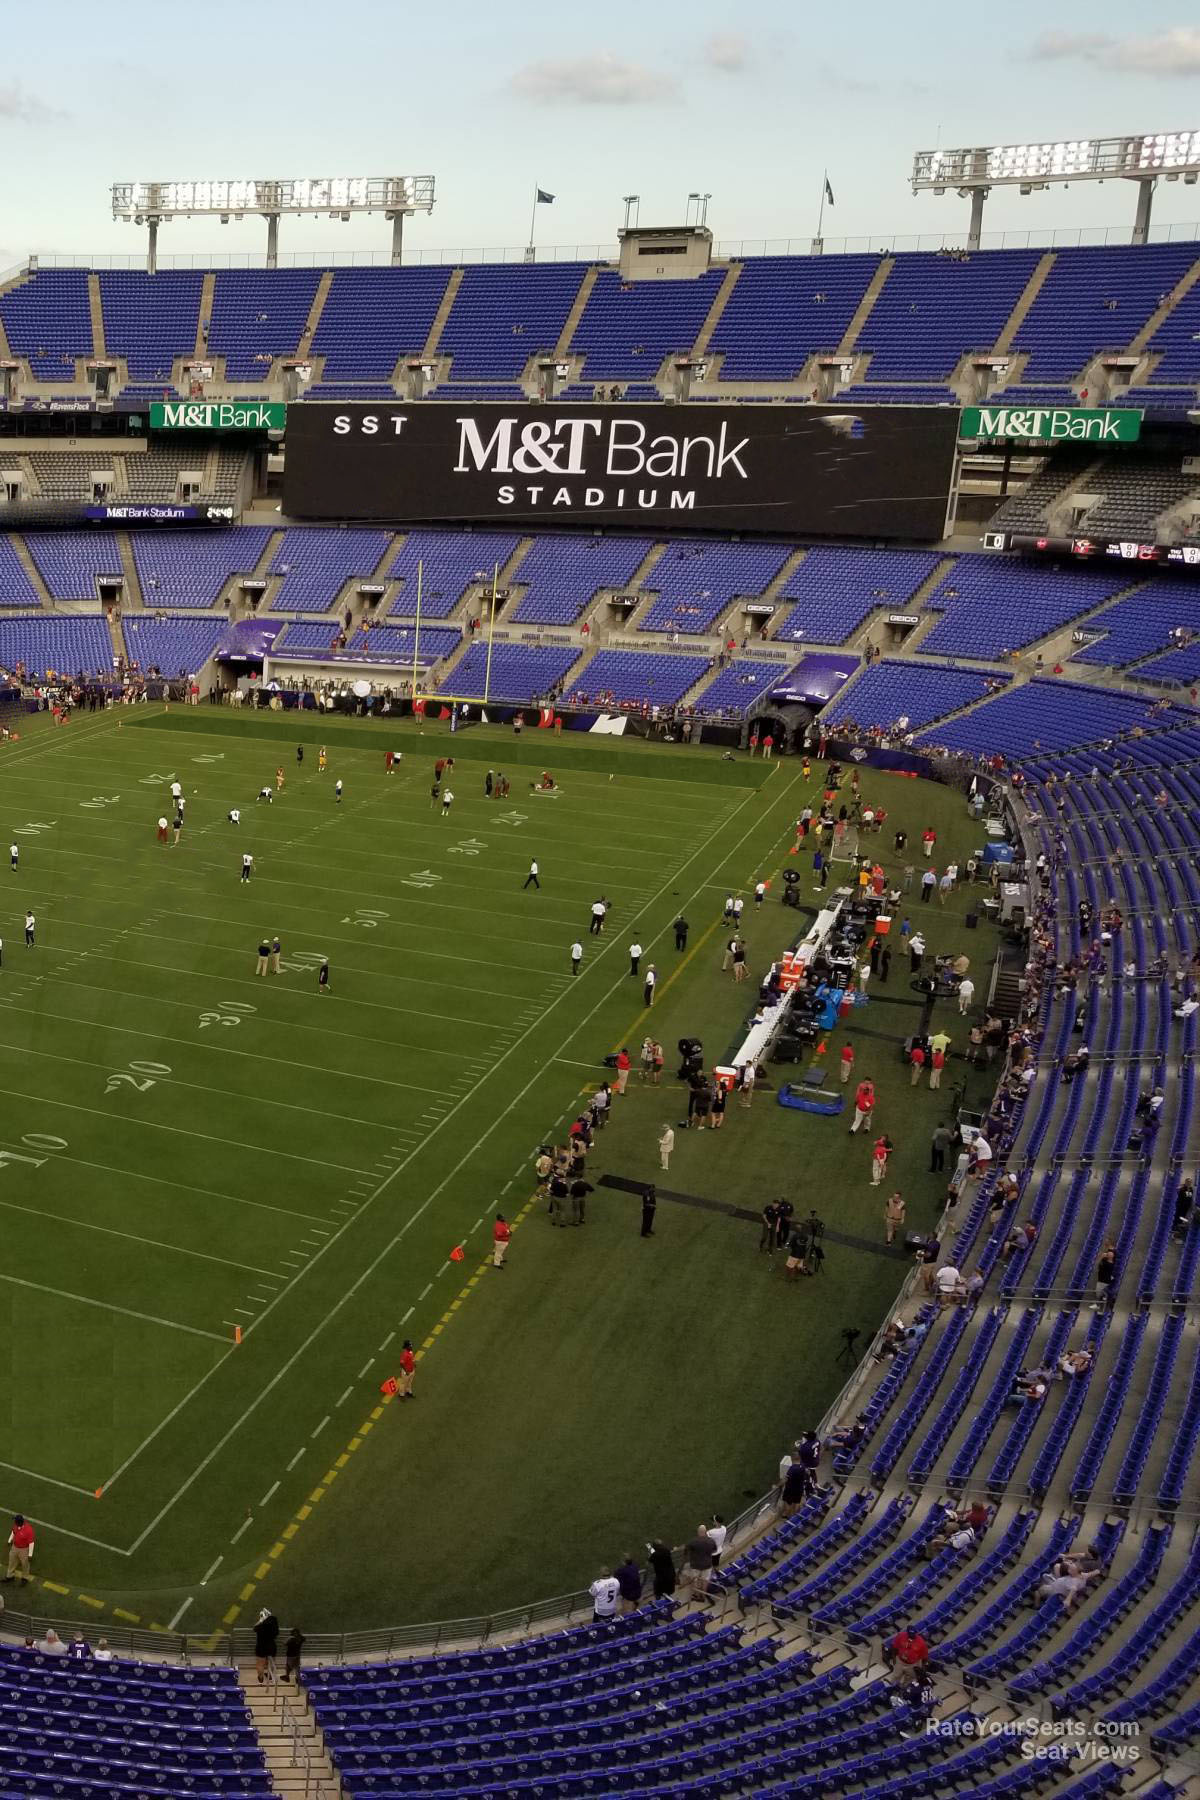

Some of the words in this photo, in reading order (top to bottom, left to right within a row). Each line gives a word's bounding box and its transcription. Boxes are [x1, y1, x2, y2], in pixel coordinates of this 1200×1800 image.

[162, 404, 218, 426] M&T
[219, 404, 271, 426] Bank
[976, 409, 1050, 437] M&T
[1050, 411, 1121, 439] Bank
[453, 418, 601, 474] M&T
[606, 420, 749, 478] Bank
[496, 485, 696, 509] STADIUM
[106, 508, 128, 517] M&T
[128, 508, 149, 517] Bank
[150, 507, 184, 517] Stadium
[106, 1060, 172, 1092] 20
[607, 1590, 615, 1603] 5
